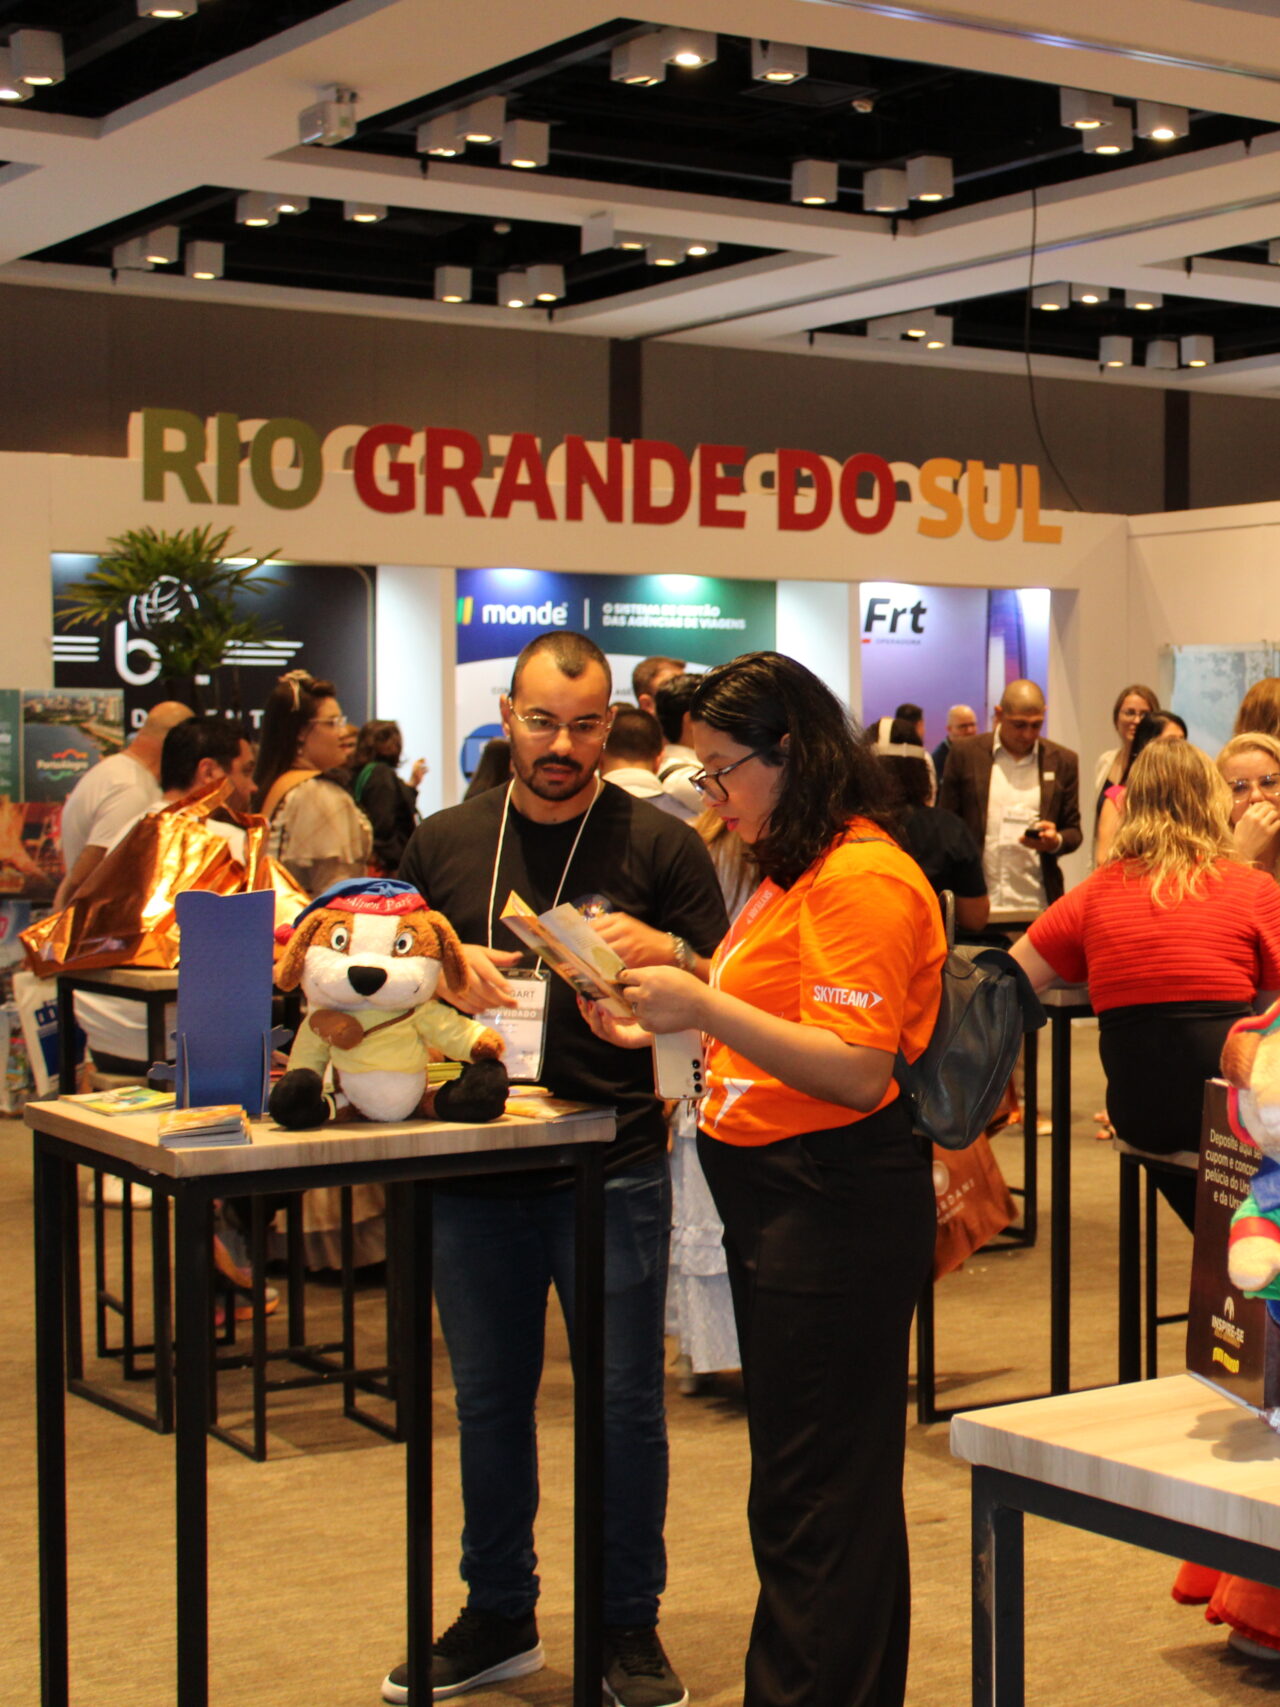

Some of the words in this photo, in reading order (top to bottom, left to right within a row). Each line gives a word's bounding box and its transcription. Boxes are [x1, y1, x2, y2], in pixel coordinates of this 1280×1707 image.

[141, 407, 324, 511] RIO
[353, 423, 747, 530] GRANDE
[776, 447, 898, 535] DO
[917, 457, 1063, 545] SUL
[482, 601, 568, 627] monde
[602, 602, 613, 615] O
[864, 597, 928, 634] Frt
[813, 984, 870, 1009] SKYTEAM
[1209, 1128, 1238, 1151] Deposite
[1234, 1160, 1259, 1177] concor
